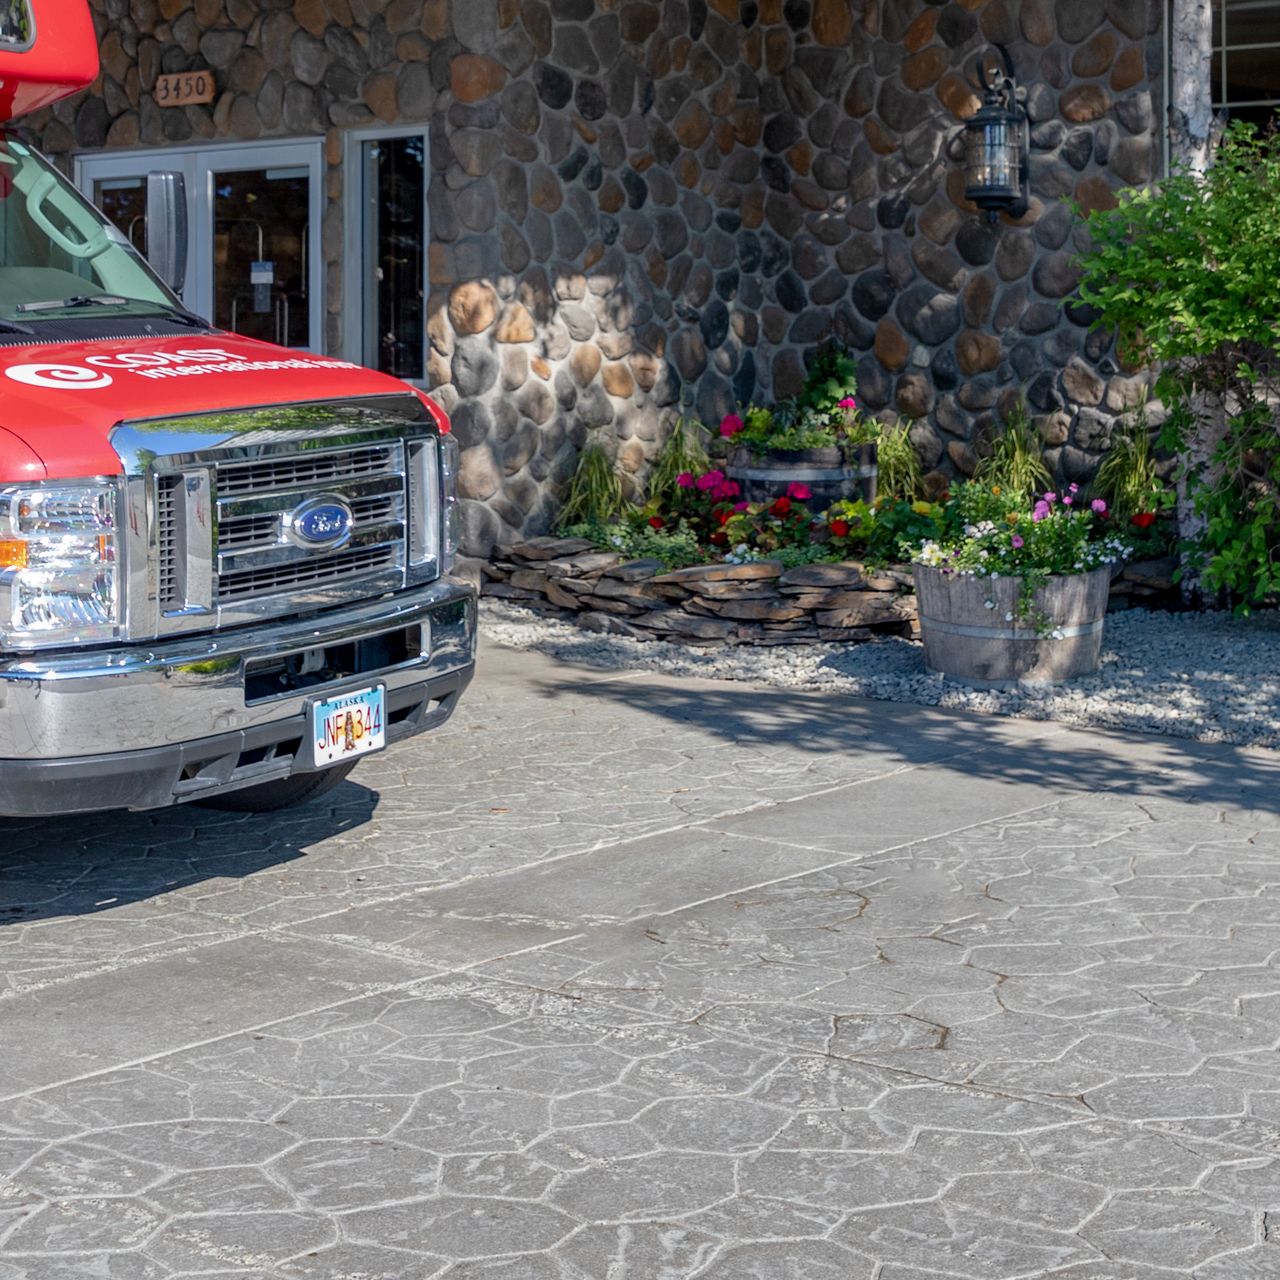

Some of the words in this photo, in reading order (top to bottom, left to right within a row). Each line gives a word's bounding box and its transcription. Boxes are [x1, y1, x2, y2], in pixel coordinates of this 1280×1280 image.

[160, 76, 206, 100] 3450
[85, 348, 248, 369] COAST
[334, 696, 365, 710] ALASKA
